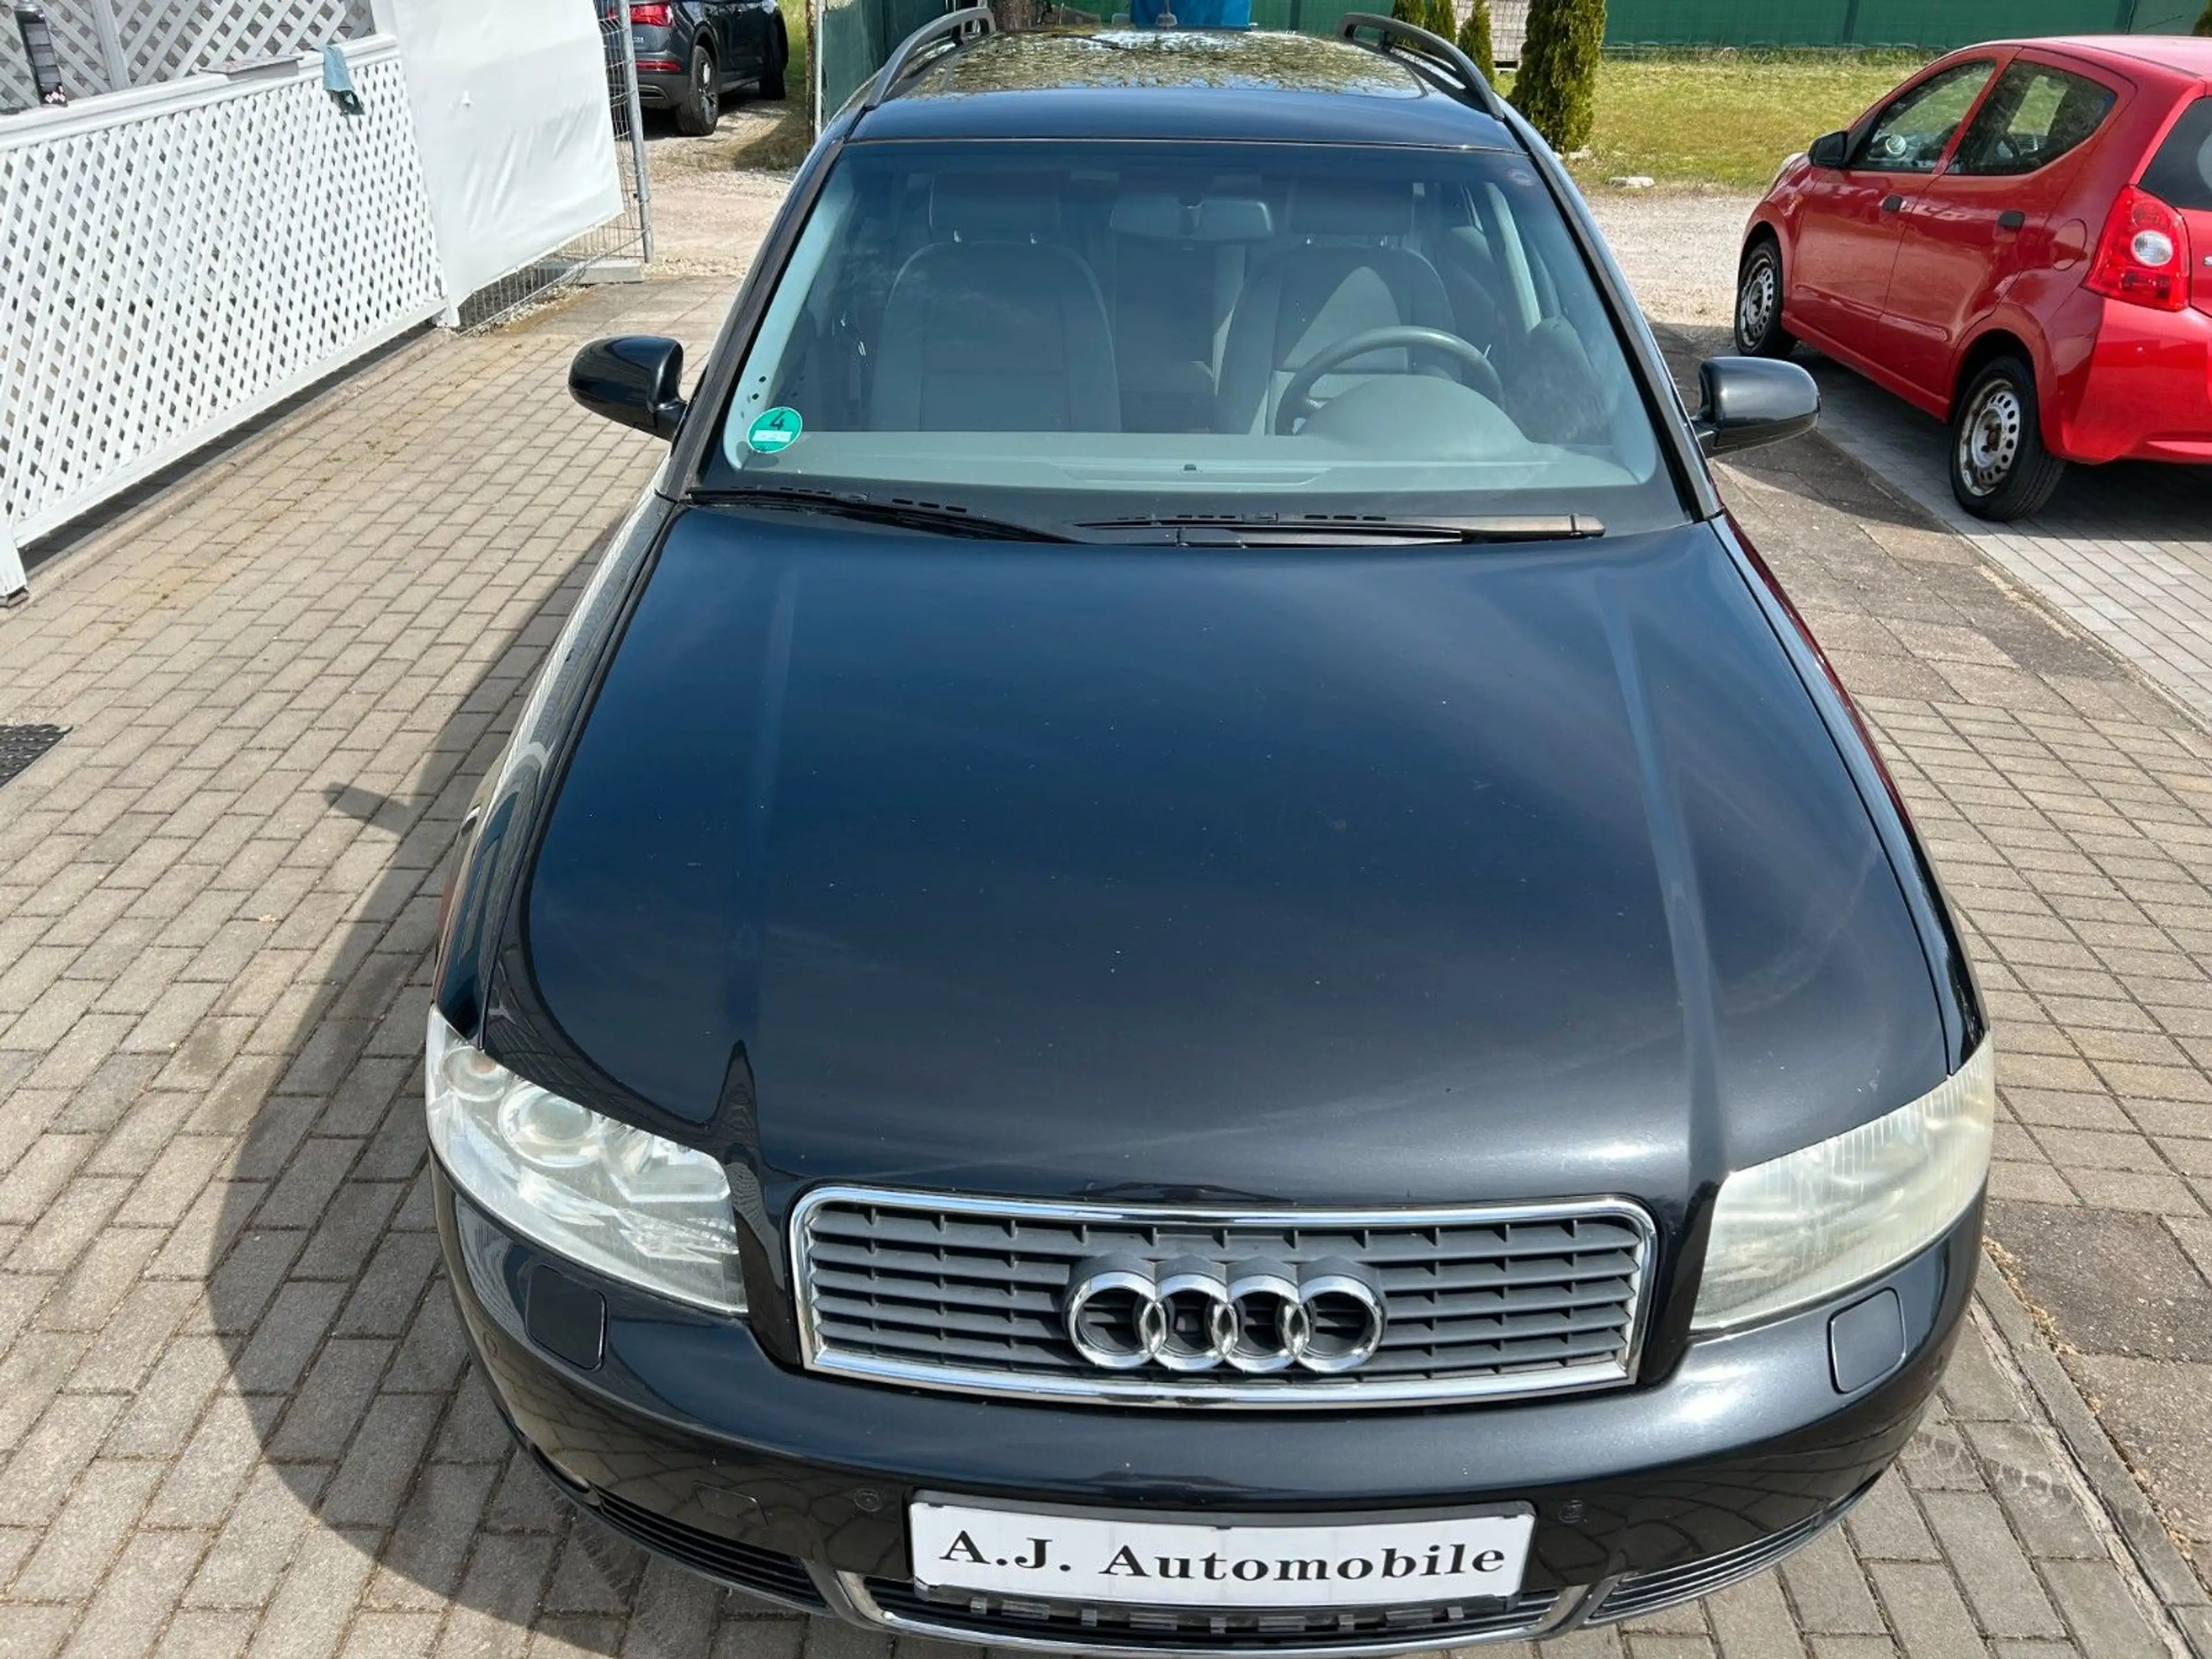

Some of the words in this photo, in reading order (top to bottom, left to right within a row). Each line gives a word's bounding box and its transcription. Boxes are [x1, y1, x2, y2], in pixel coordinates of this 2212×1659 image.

[770, 411, 786, 430] 4
[939, 1529, 1071, 1572] A.J.
[1098, 1543, 1505, 1582] Automobile
